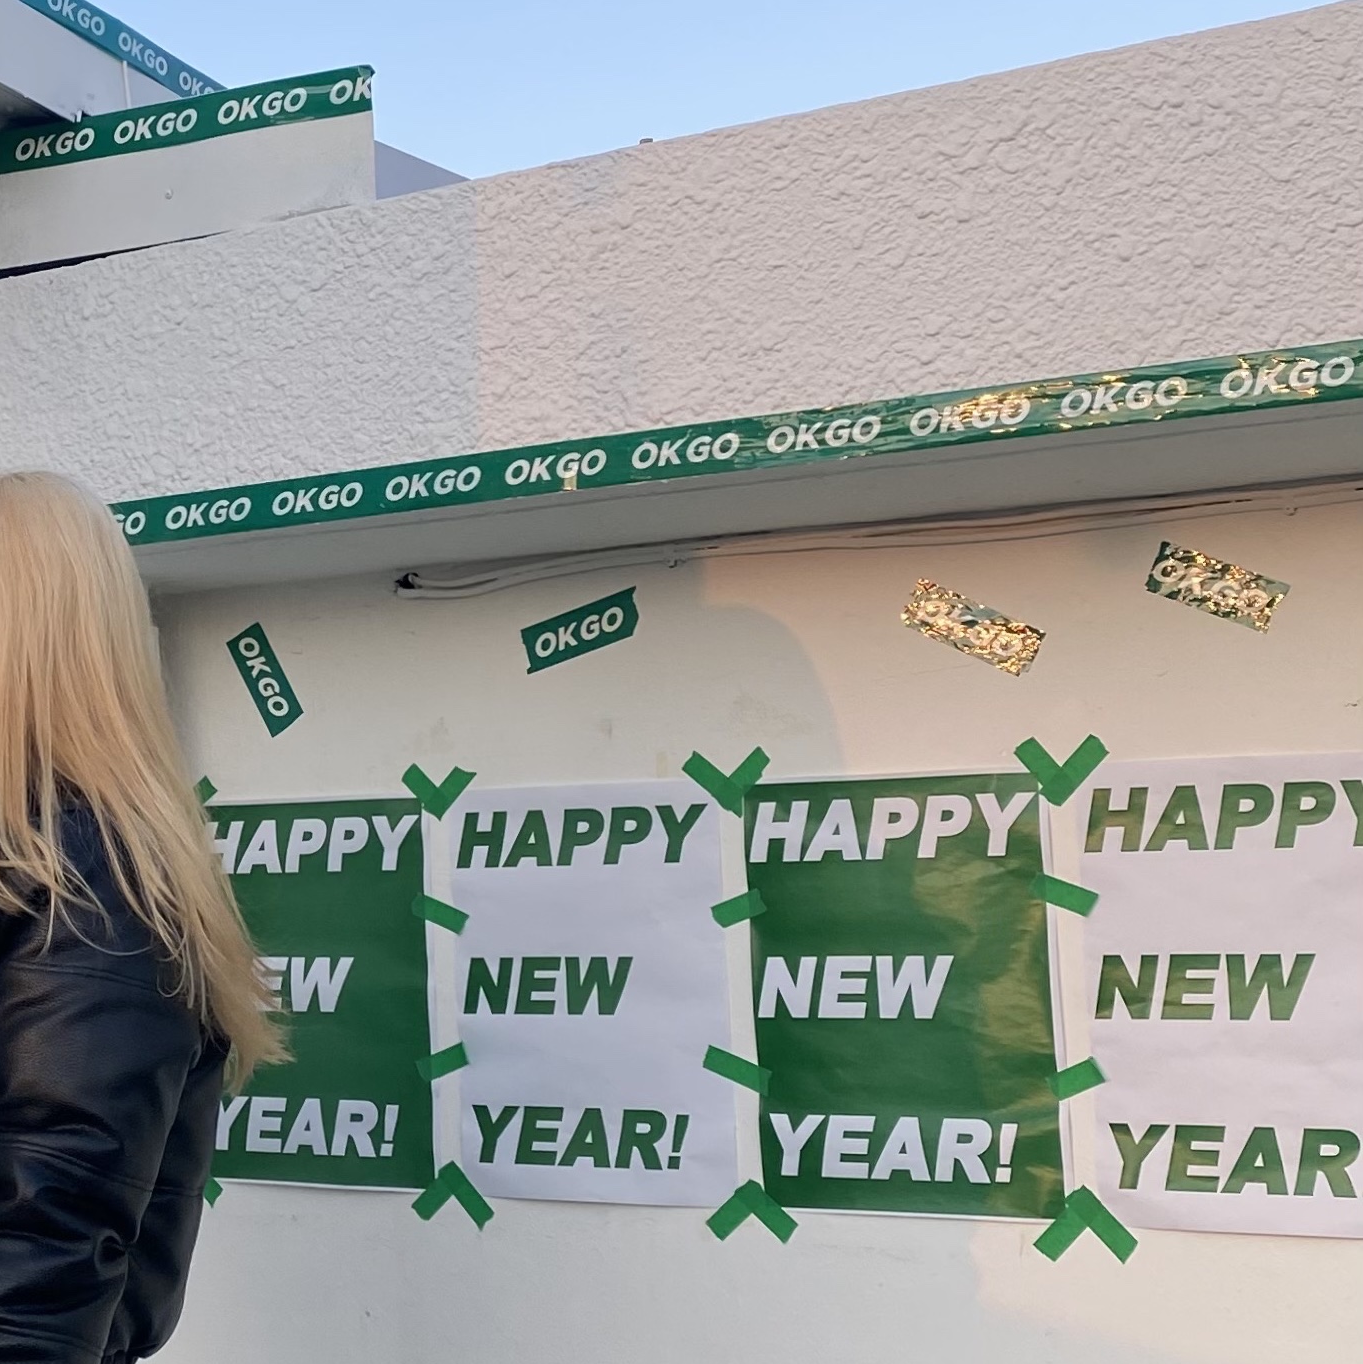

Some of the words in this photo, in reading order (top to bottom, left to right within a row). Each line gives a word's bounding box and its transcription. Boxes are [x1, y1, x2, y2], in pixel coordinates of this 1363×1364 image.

[118, 32, 168, 76] OKGO
[15, 127, 94, 162] OKGO
[114, 108, 197, 145] OKGO
[217, 87, 308, 125] OKGO
[165, 497, 251, 531] OKGO
[272, 481, 364, 516] OKGO
[385, 465, 482, 502] OKGO
[504, 448, 608, 485] OKGO
[631, 432, 738, 468] OKGO
[767, 415, 881, 455] OKGO
[1061, 377, 1188, 418] OKGO
[1221, 356, 1354, 399] OKGO
[535, 606, 623, 658] OKGO
[238, 636, 289, 717] OKGO
[207, 815, 419, 875] HAPPY
[456, 803, 708, 868] HAPPY
[750, 791, 1035, 863] HAPPY
[253, 957, 353, 1013] EW
[463, 957, 633, 1015] NEW
[759, 955, 954, 1019] NEW
[1094, 953, 1315, 1021] NEW
[215, 1096, 399, 1158] YEAR!
[473, 1104, 689, 1171] YEAR!
[770, 1114, 1019, 1183] YEAR!
